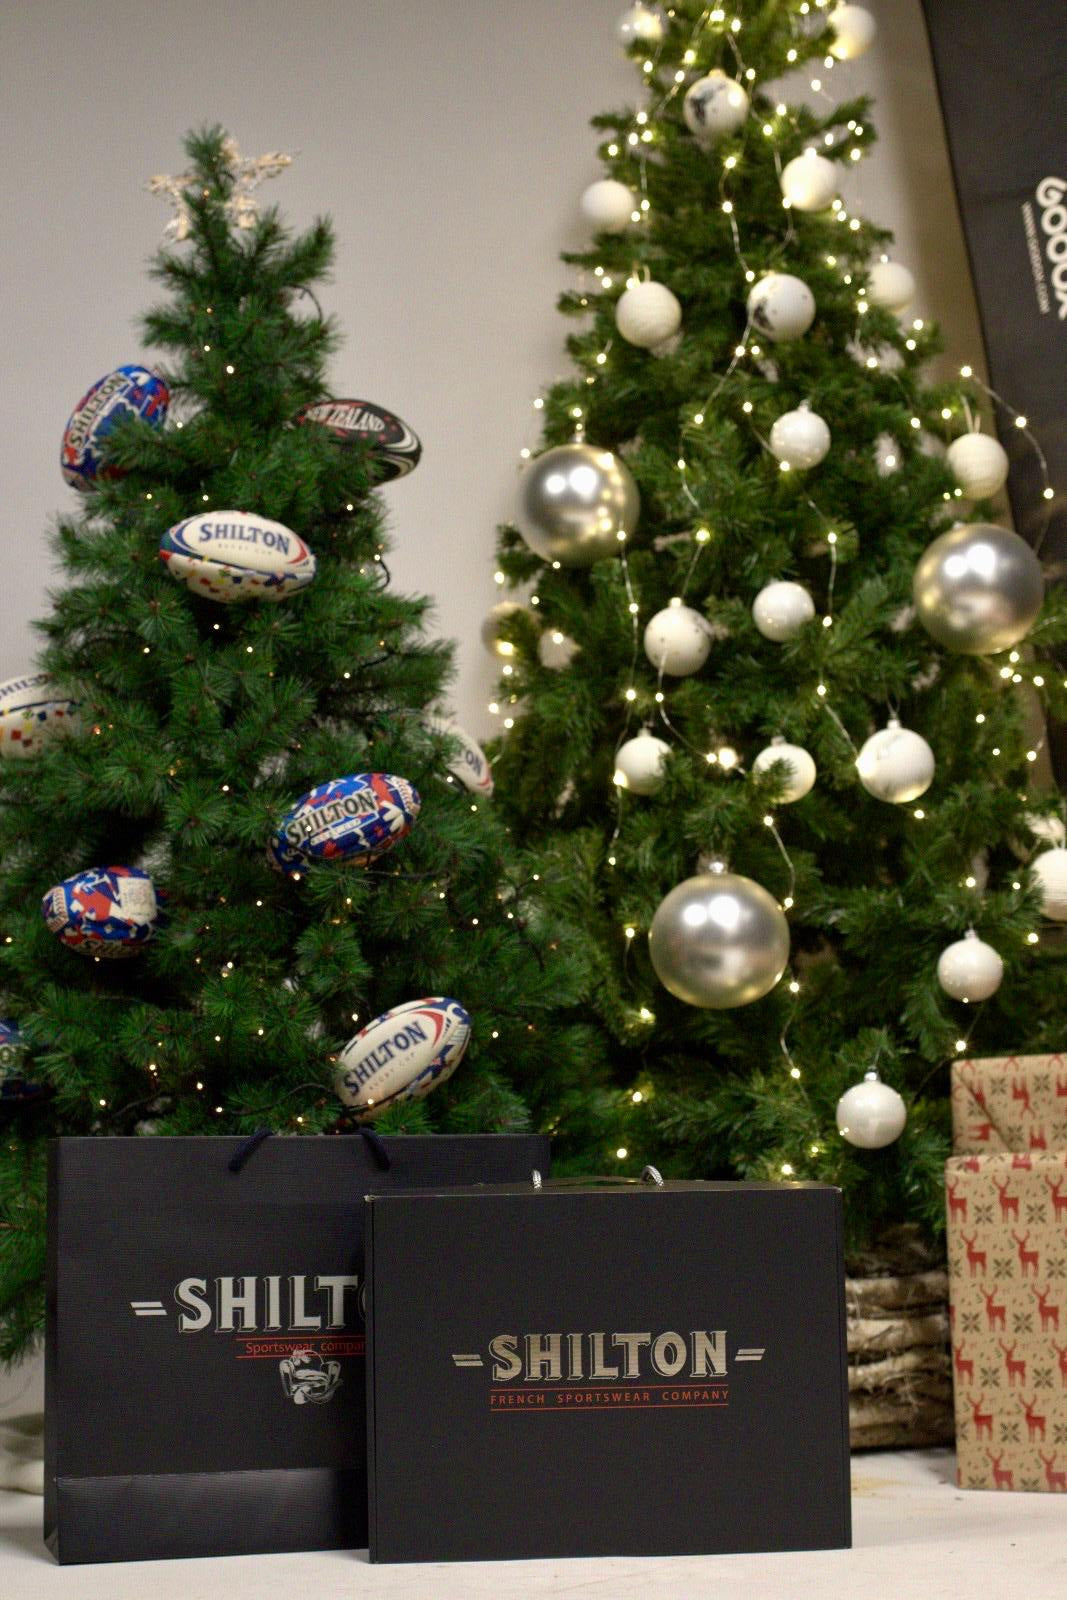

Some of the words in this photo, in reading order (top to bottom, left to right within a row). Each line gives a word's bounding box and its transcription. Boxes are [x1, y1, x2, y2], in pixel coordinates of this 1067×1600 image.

[69, 374, 126, 447] SHILTON
[199, 523, 290, 555] SHILTON
[286, 790, 377, 844] SHILTON
[344, 1021, 427, 1096] SHILTON
[174, 1275, 365, 1333] SHILT
[245, 1342, 315, 1357] Sportswear
[488, 1330, 728, 1381] SHILTON
[490, 1393, 545, 1405] FRENCH
[557, 1392, 650, 1404] SPORTSWEAR
[662, 1390, 729, 1402] COMPANY
